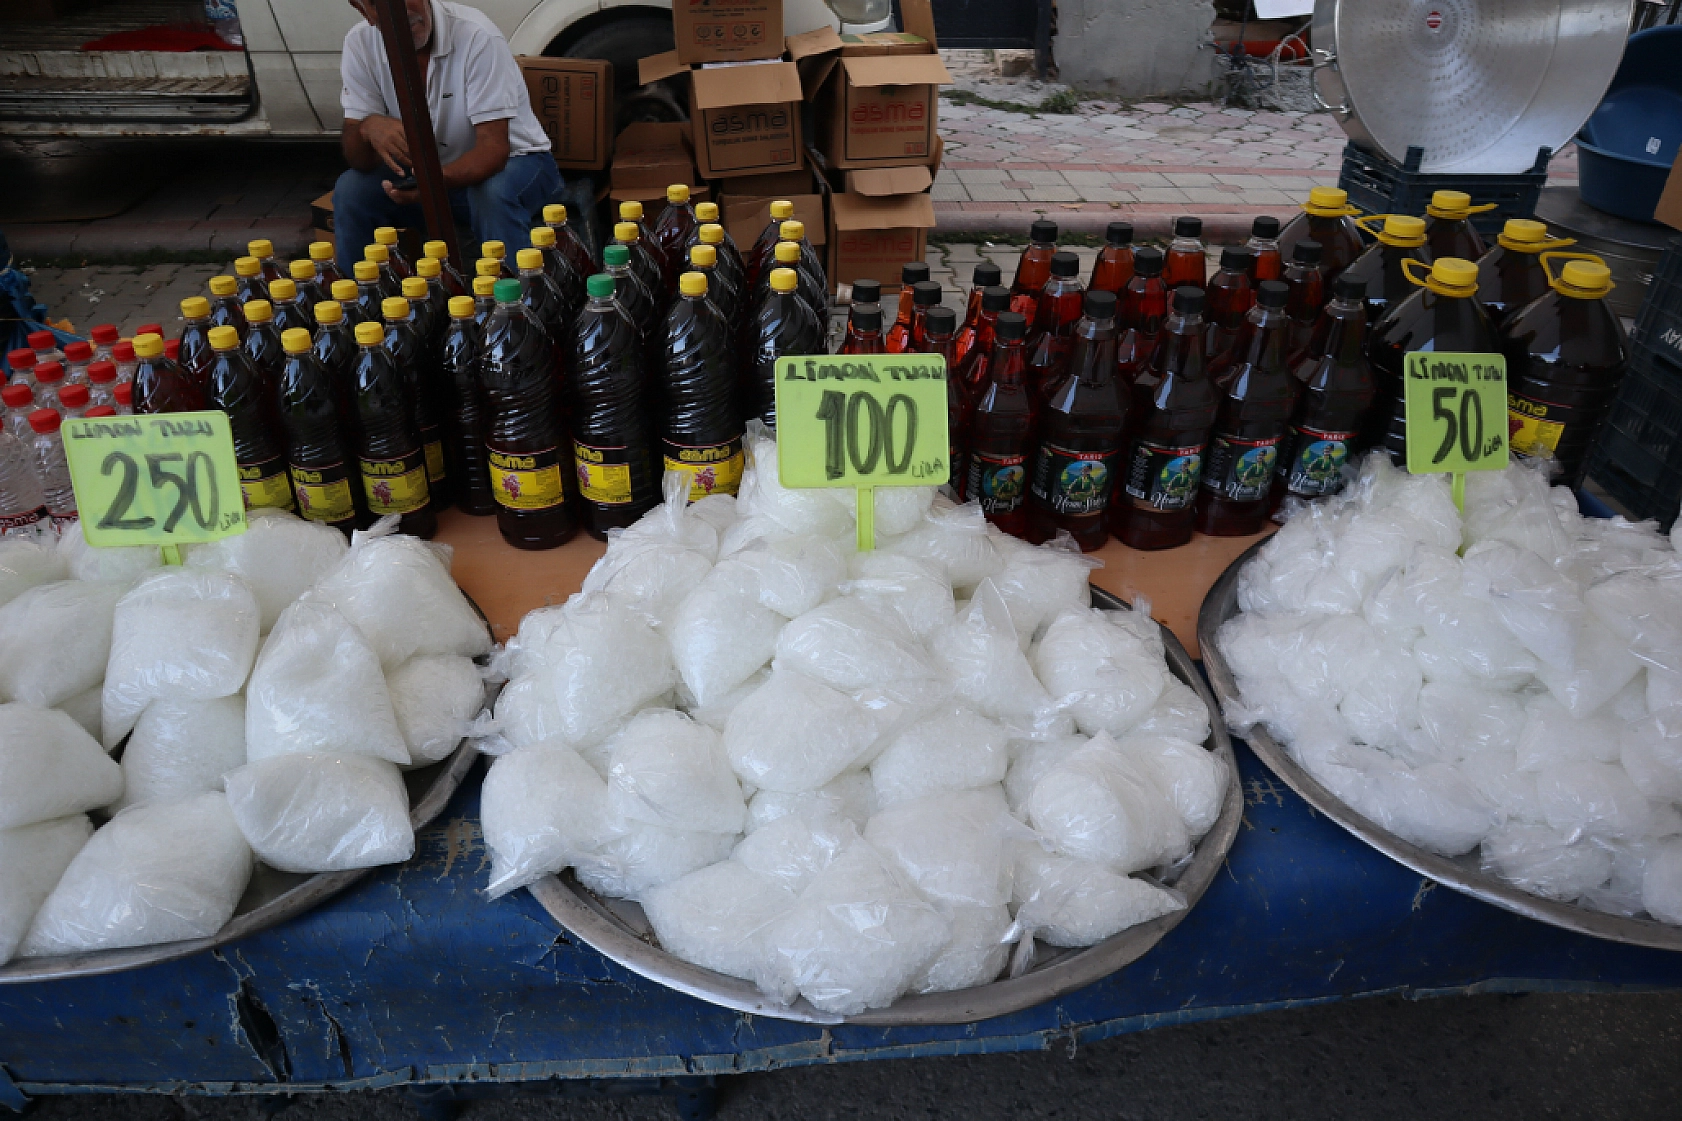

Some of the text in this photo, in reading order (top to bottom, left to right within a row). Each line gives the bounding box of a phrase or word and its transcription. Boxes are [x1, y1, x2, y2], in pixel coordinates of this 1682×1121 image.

[712, 110, 787, 135] asma
[851, 101, 925, 124] asma
[816, 389, 919, 481] 100
[1432, 386, 1483, 464] 50
[678, 445, 730, 462] asma
[96, 450, 220, 534] 250
